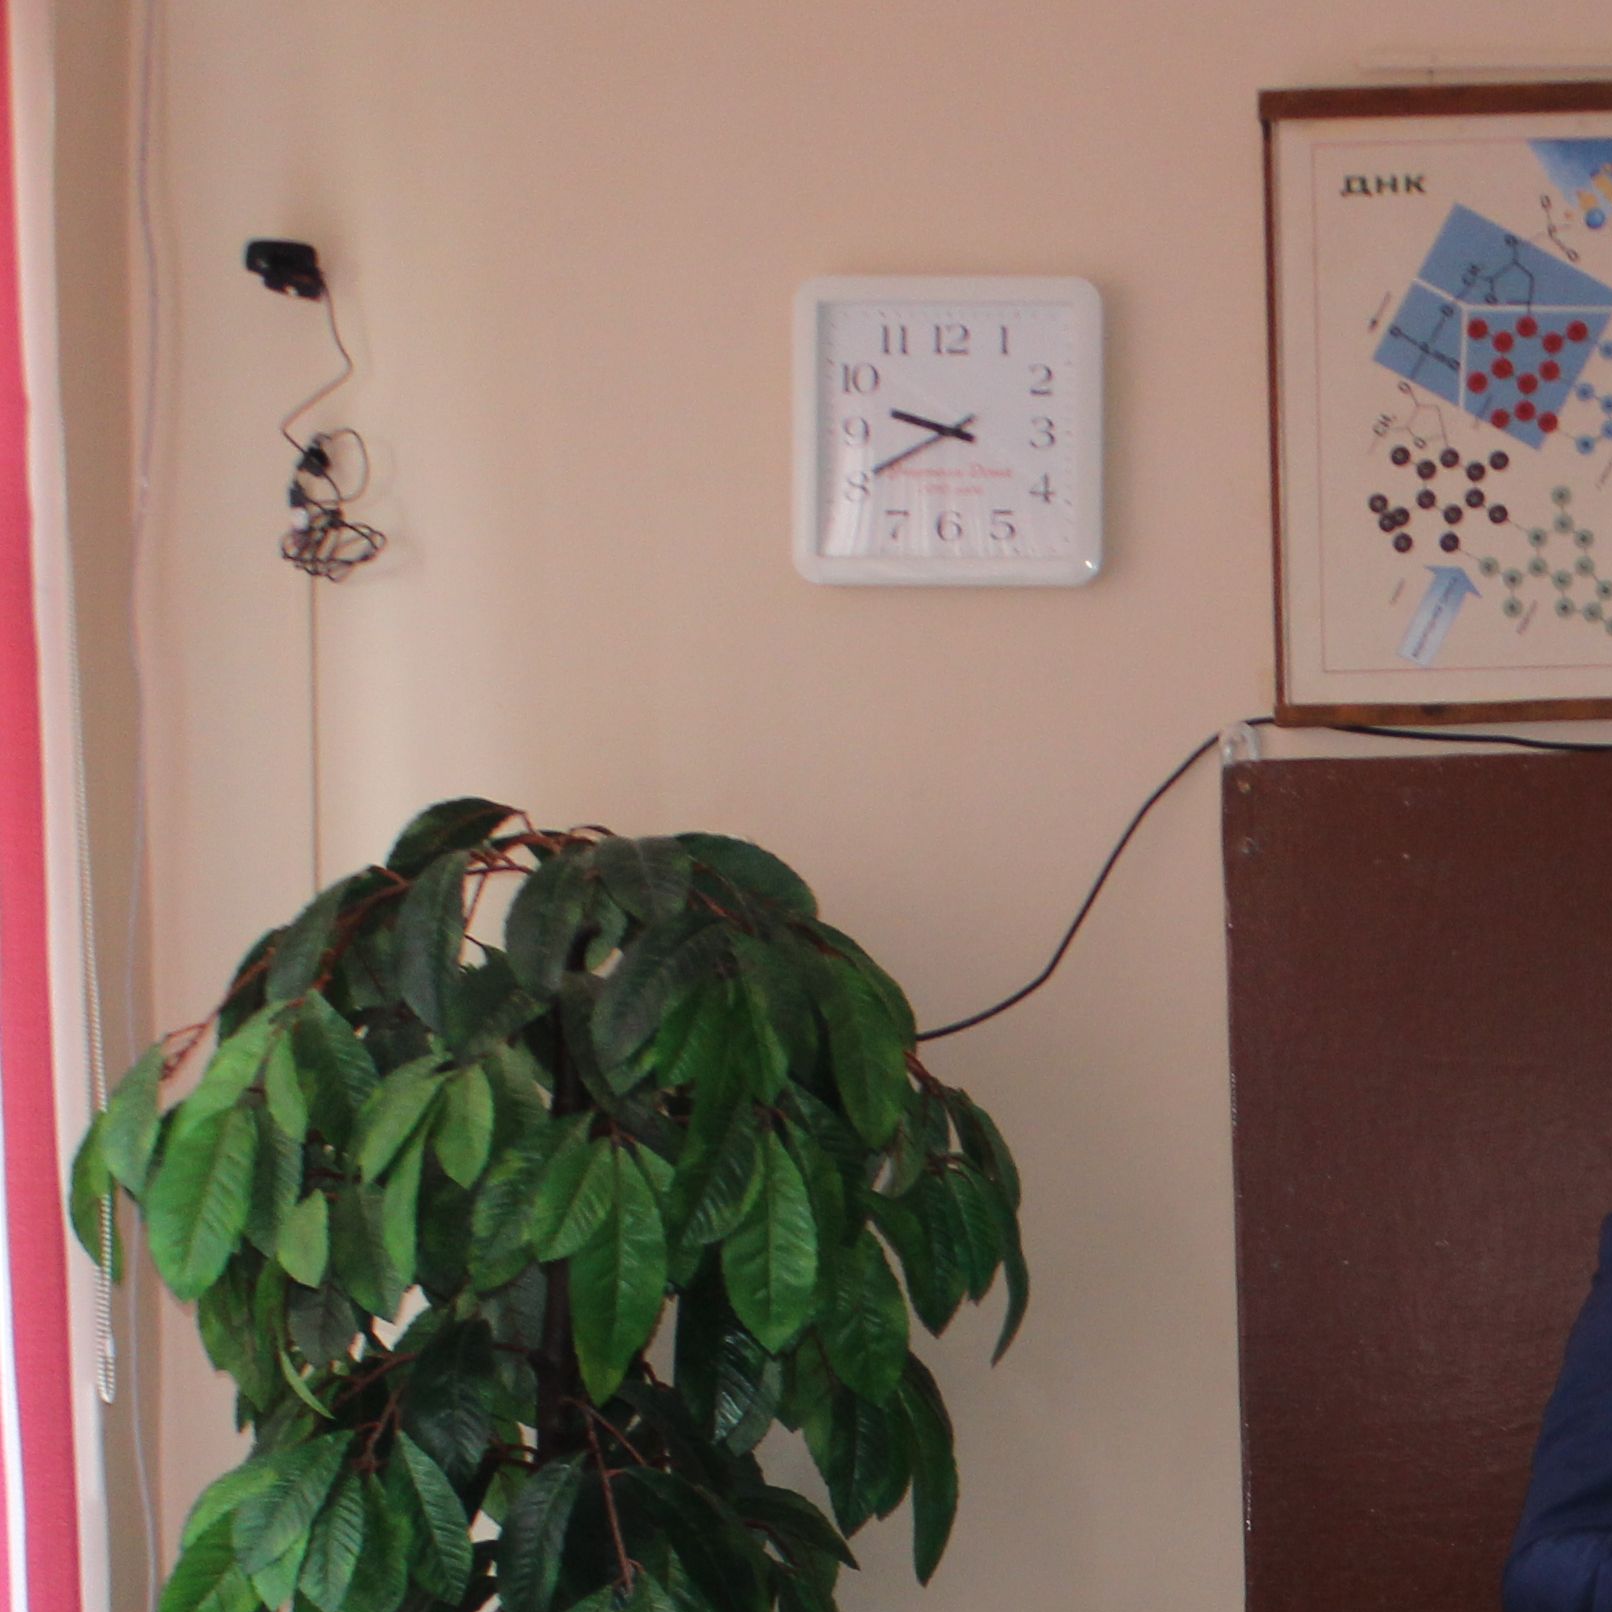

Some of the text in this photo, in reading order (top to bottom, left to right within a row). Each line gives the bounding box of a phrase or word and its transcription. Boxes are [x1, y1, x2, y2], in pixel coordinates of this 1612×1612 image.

[1340, 172, 1427, 197] ДНК
[880, 324, 909, 356] 11
[932, 323, 971, 355] 12
[997, 324, 1010, 355] 1
[841, 362, 880, 395] 10
[1029, 364, 1053, 396] 2
[843, 416, 870, 447] 9
[1030, 417, 1055, 449] 3
[844, 471, 871, 502] 8
[1029, 473, 1055, 504] 4
[884, 510, 909, 540] 7
[936, 510, 963, 541] 6
[990, 509, 1016, 540] 5
